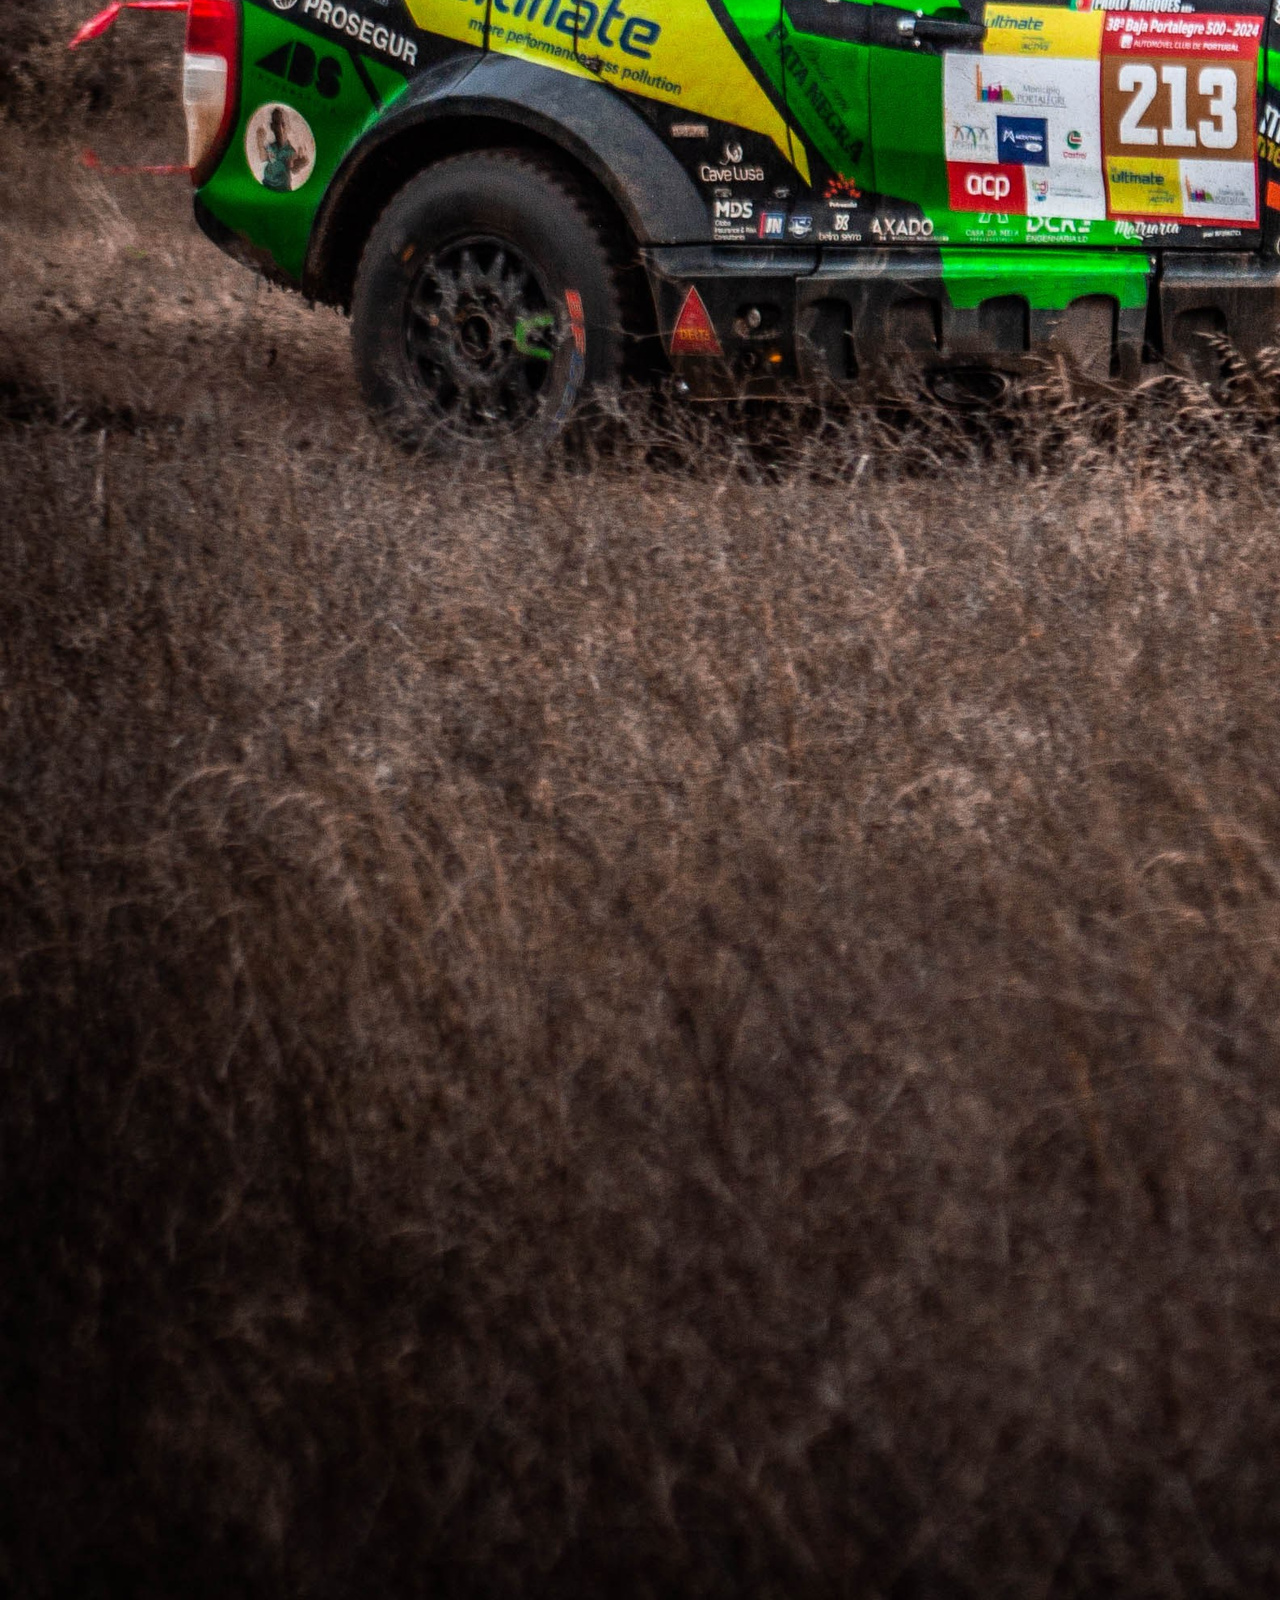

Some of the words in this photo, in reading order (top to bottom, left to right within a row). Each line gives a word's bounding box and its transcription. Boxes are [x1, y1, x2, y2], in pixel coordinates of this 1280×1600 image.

[986, 15, 1044, 31] ultimate
[1126, 18, 1148, 36] Baja
[1150, 19, 1205, 38] Portalegre
[1203, 41, 1239, 52] PORTUGAL
[621, 66, 682, 96] pollution
[1118, 64, 1238, 149] 213
[966, 174, 1011, 200] acp
[1111, 170, 1165, 185] ultimate
[715, 201, 753, 219] MDS
[872, 217, 934, 236] AXADO
